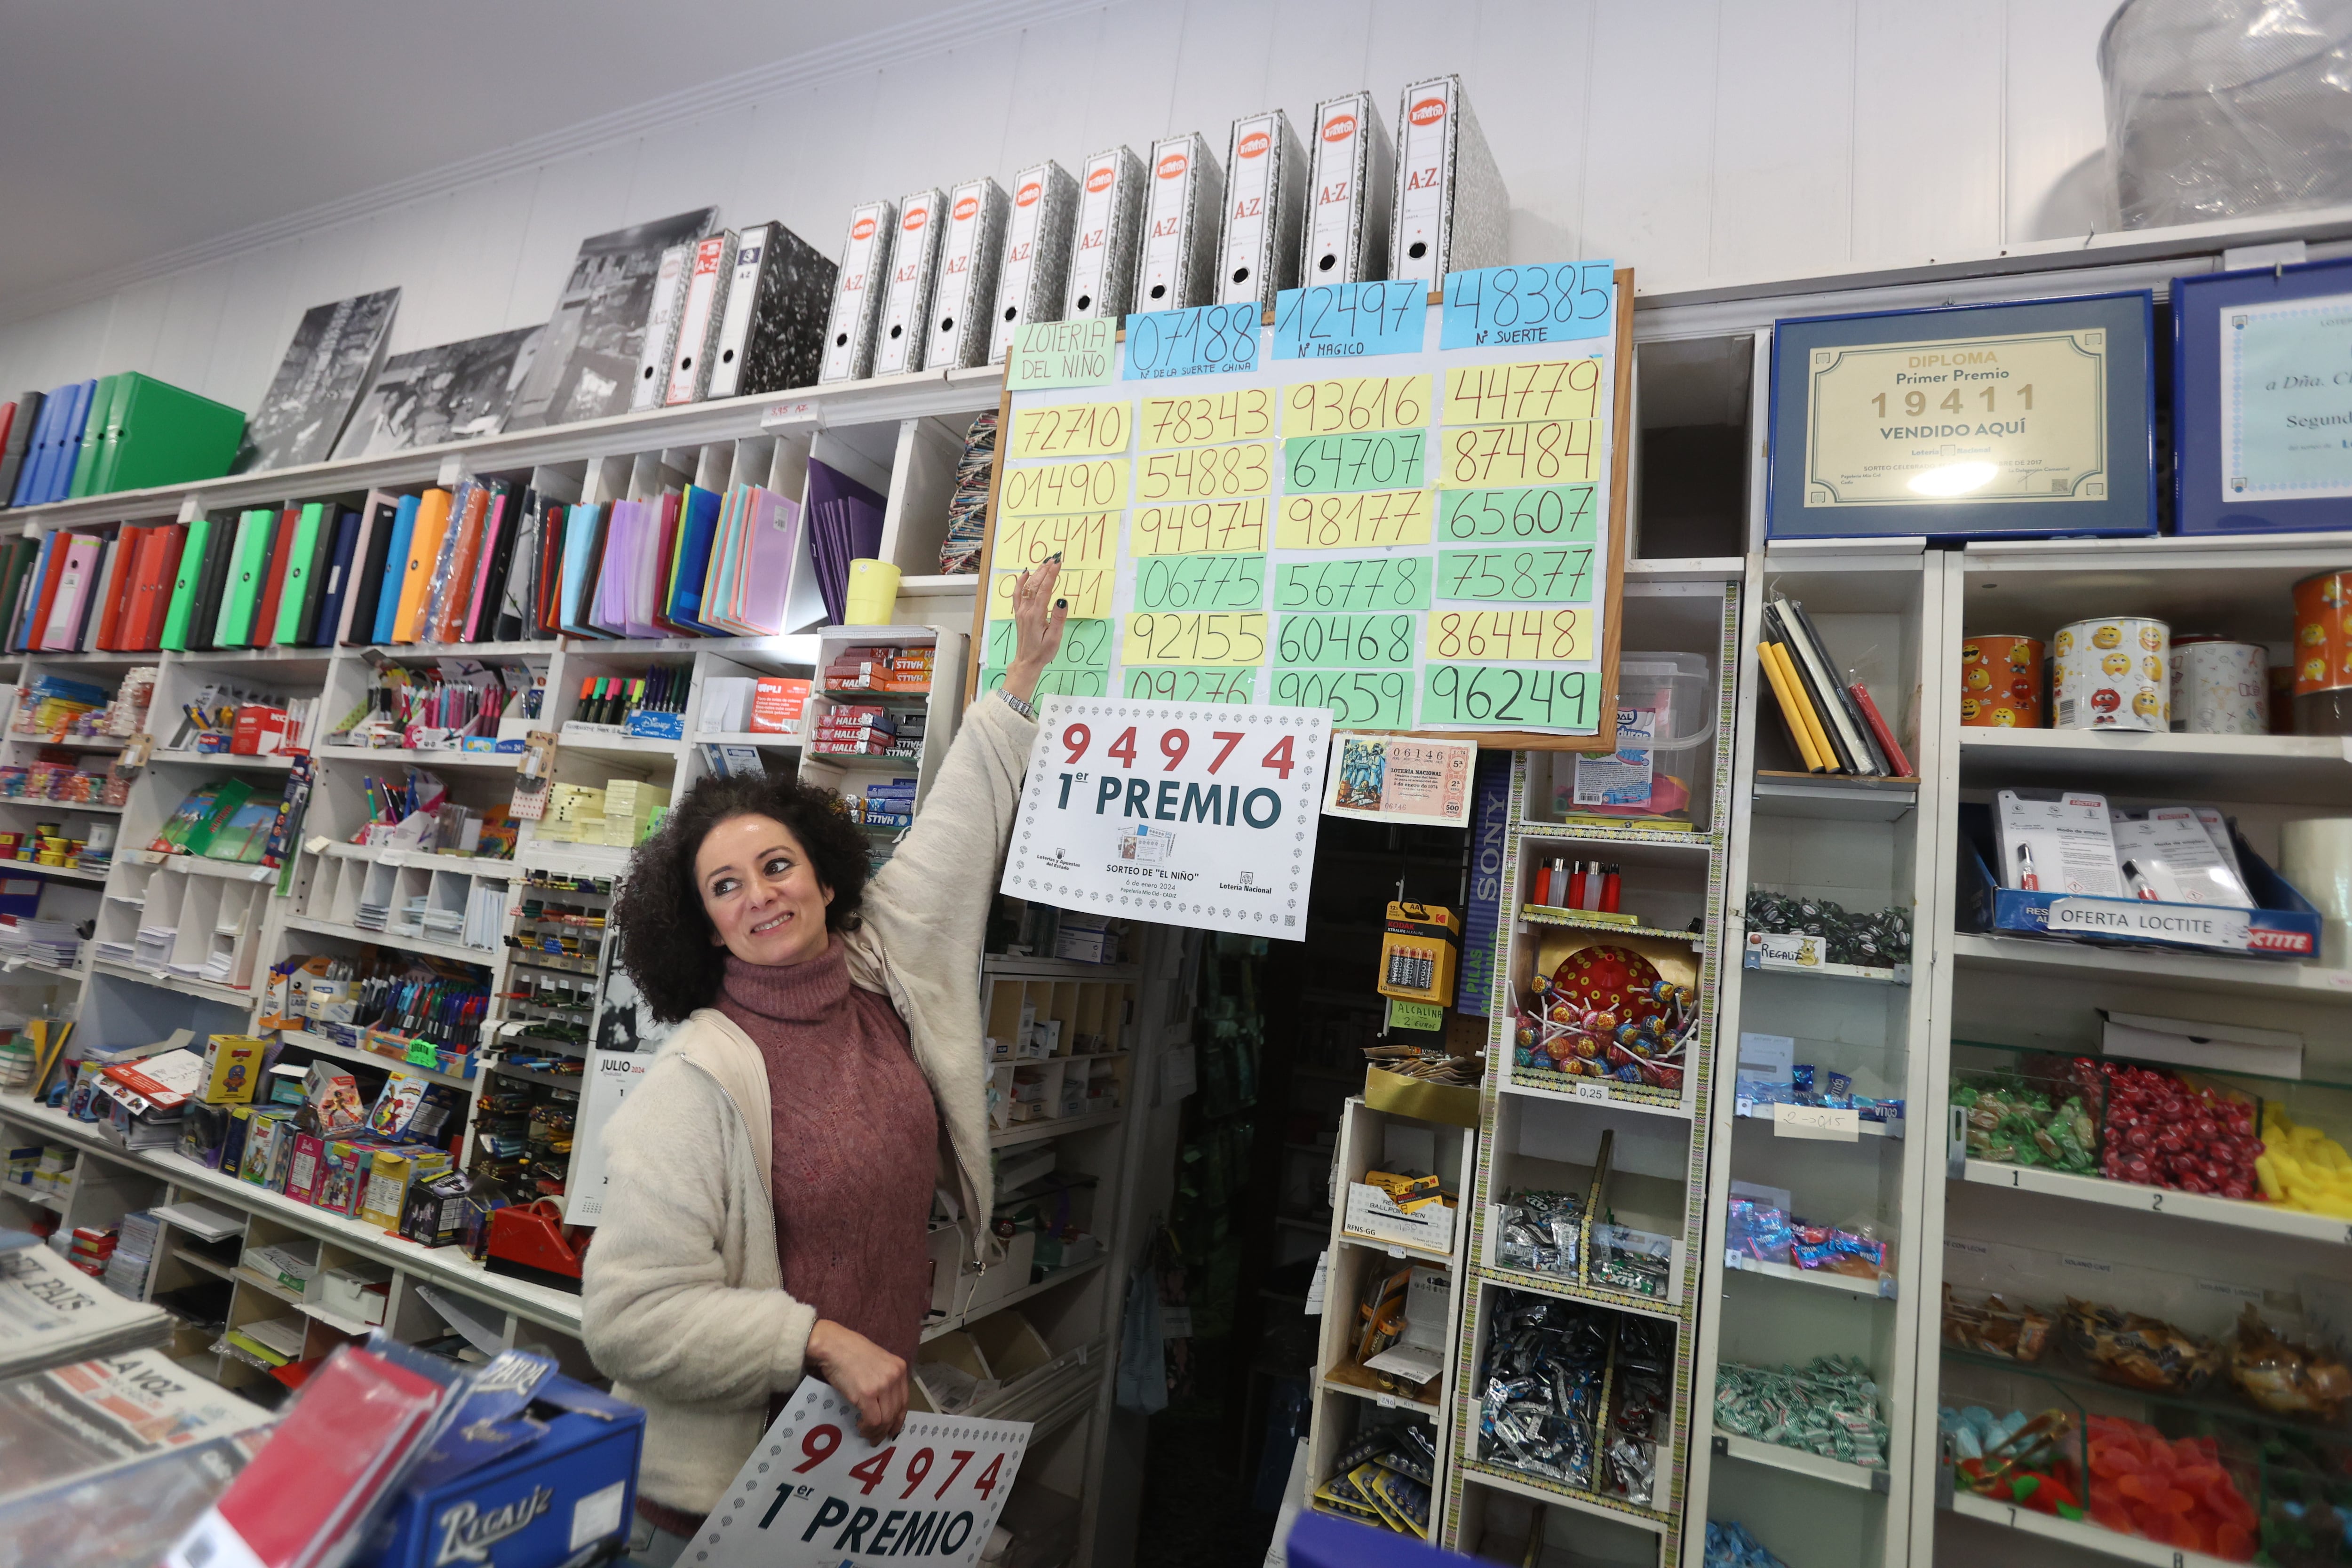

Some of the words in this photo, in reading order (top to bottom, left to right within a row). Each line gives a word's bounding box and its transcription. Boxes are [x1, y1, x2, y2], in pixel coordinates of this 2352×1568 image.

[1279, 282, 1418, 341] 12497
[1454, 265, 1609, 328] 48385
[1133, 304, 1255, 370] 07188
[1317, 342, 1364, 356] MAGICO
[1494, 327, 1548, 343] SUERTE
[1022, 359, 1051, 379] DEL
[1062, 350, 1105, 378] NIÑO
[1182, 364, 1216, 375] SUERTE
[1222, 362, 1251, 372] CHINA
[1896, 372, 1948, 385] Primer
[1953, 367, 2010, 382] Premio
[1908, 351, 1998, 369] DIPLOMA
[1293, 377, 1419, 431] 93616
[1455, 360, 1599, 419] 44779
[1871, 384, 2033, 418] 19411
[2266, 381, 2276, 391] a
[1024, 406, 1120, 453] 72710
[1152, 390, 1268, 443] 78343
[1880, 424, 1971, 440] VENDIDO
[1975, 418, 2026, 437] AQUÍ
[1144, 445, 1268, 498] 54883
[1294, 434, 1421, 488] 64707
[1455, 420, 1592, 482] 87484
[1007, 461, 1115, 509] 01490
[1141, 497, 1264, 552] 94974
[1289, 491, 1422, 545] 98177
[1451, 486, 1593, 538] 65607
[999, 571, 1103, 614] 941
[1144, 557, 1264, 607] 06775
[1283, 558, 1417, 607] 56778
[1452, 549, 1592, 598] 75877
[994, 621, 1106, 665] 162
[1134, 614, 1264, 661] 92155
[1280, 615, 1409, 662] 60468
[1438, 610, 1576, 659] 86448
[1278, 673, 1404, 725] 90659
[1432, 666, 1585, 724] 96249
[1062, 723, 1295, 780] 94974
[1393, 748, 1443, 760] 06146
[866, 814, 895, 824] HALLS
[1096, 776, 1282, 828] PREMIO
[1478, 792, 1505, 901] SONY
[1106, 864, 1140, 876] SORTEO
[1142, 868, 1153, 877] DE
[1244, 884, 1272, 894] Nacional
[1388, 921, 1415, 930] KODAK
[2061, 909, 2129, 927] OFERTA
[2140, 915, 2213, 934] LOCTITE
[1466, 948, 1483, 993] PILAS
[1398, 1003, 1442, 1019] ALCALINA
[1404, 1017, 1411, 1026] 2
[601, 1059, 630, 1072] JULIO
[1580, 1087, 1602, 1100] 0,25
[1783, 1112, 1796, 1124] 2
[2012, 1170, 2019, 1186] 1
[2153, 1194, 2163, 1210] 2
[1347, 1224, 1376, 1235] RFNS-GG
[2065, 1259, 2092, 1269] SOLANO
[130, 1369, 186, 1397] VOZ
[792, 1424, 1005, 1502] 94974
[801, 1496, 974, 1556] PREMIO
[2008, 1508, 2017, 1526] 7
